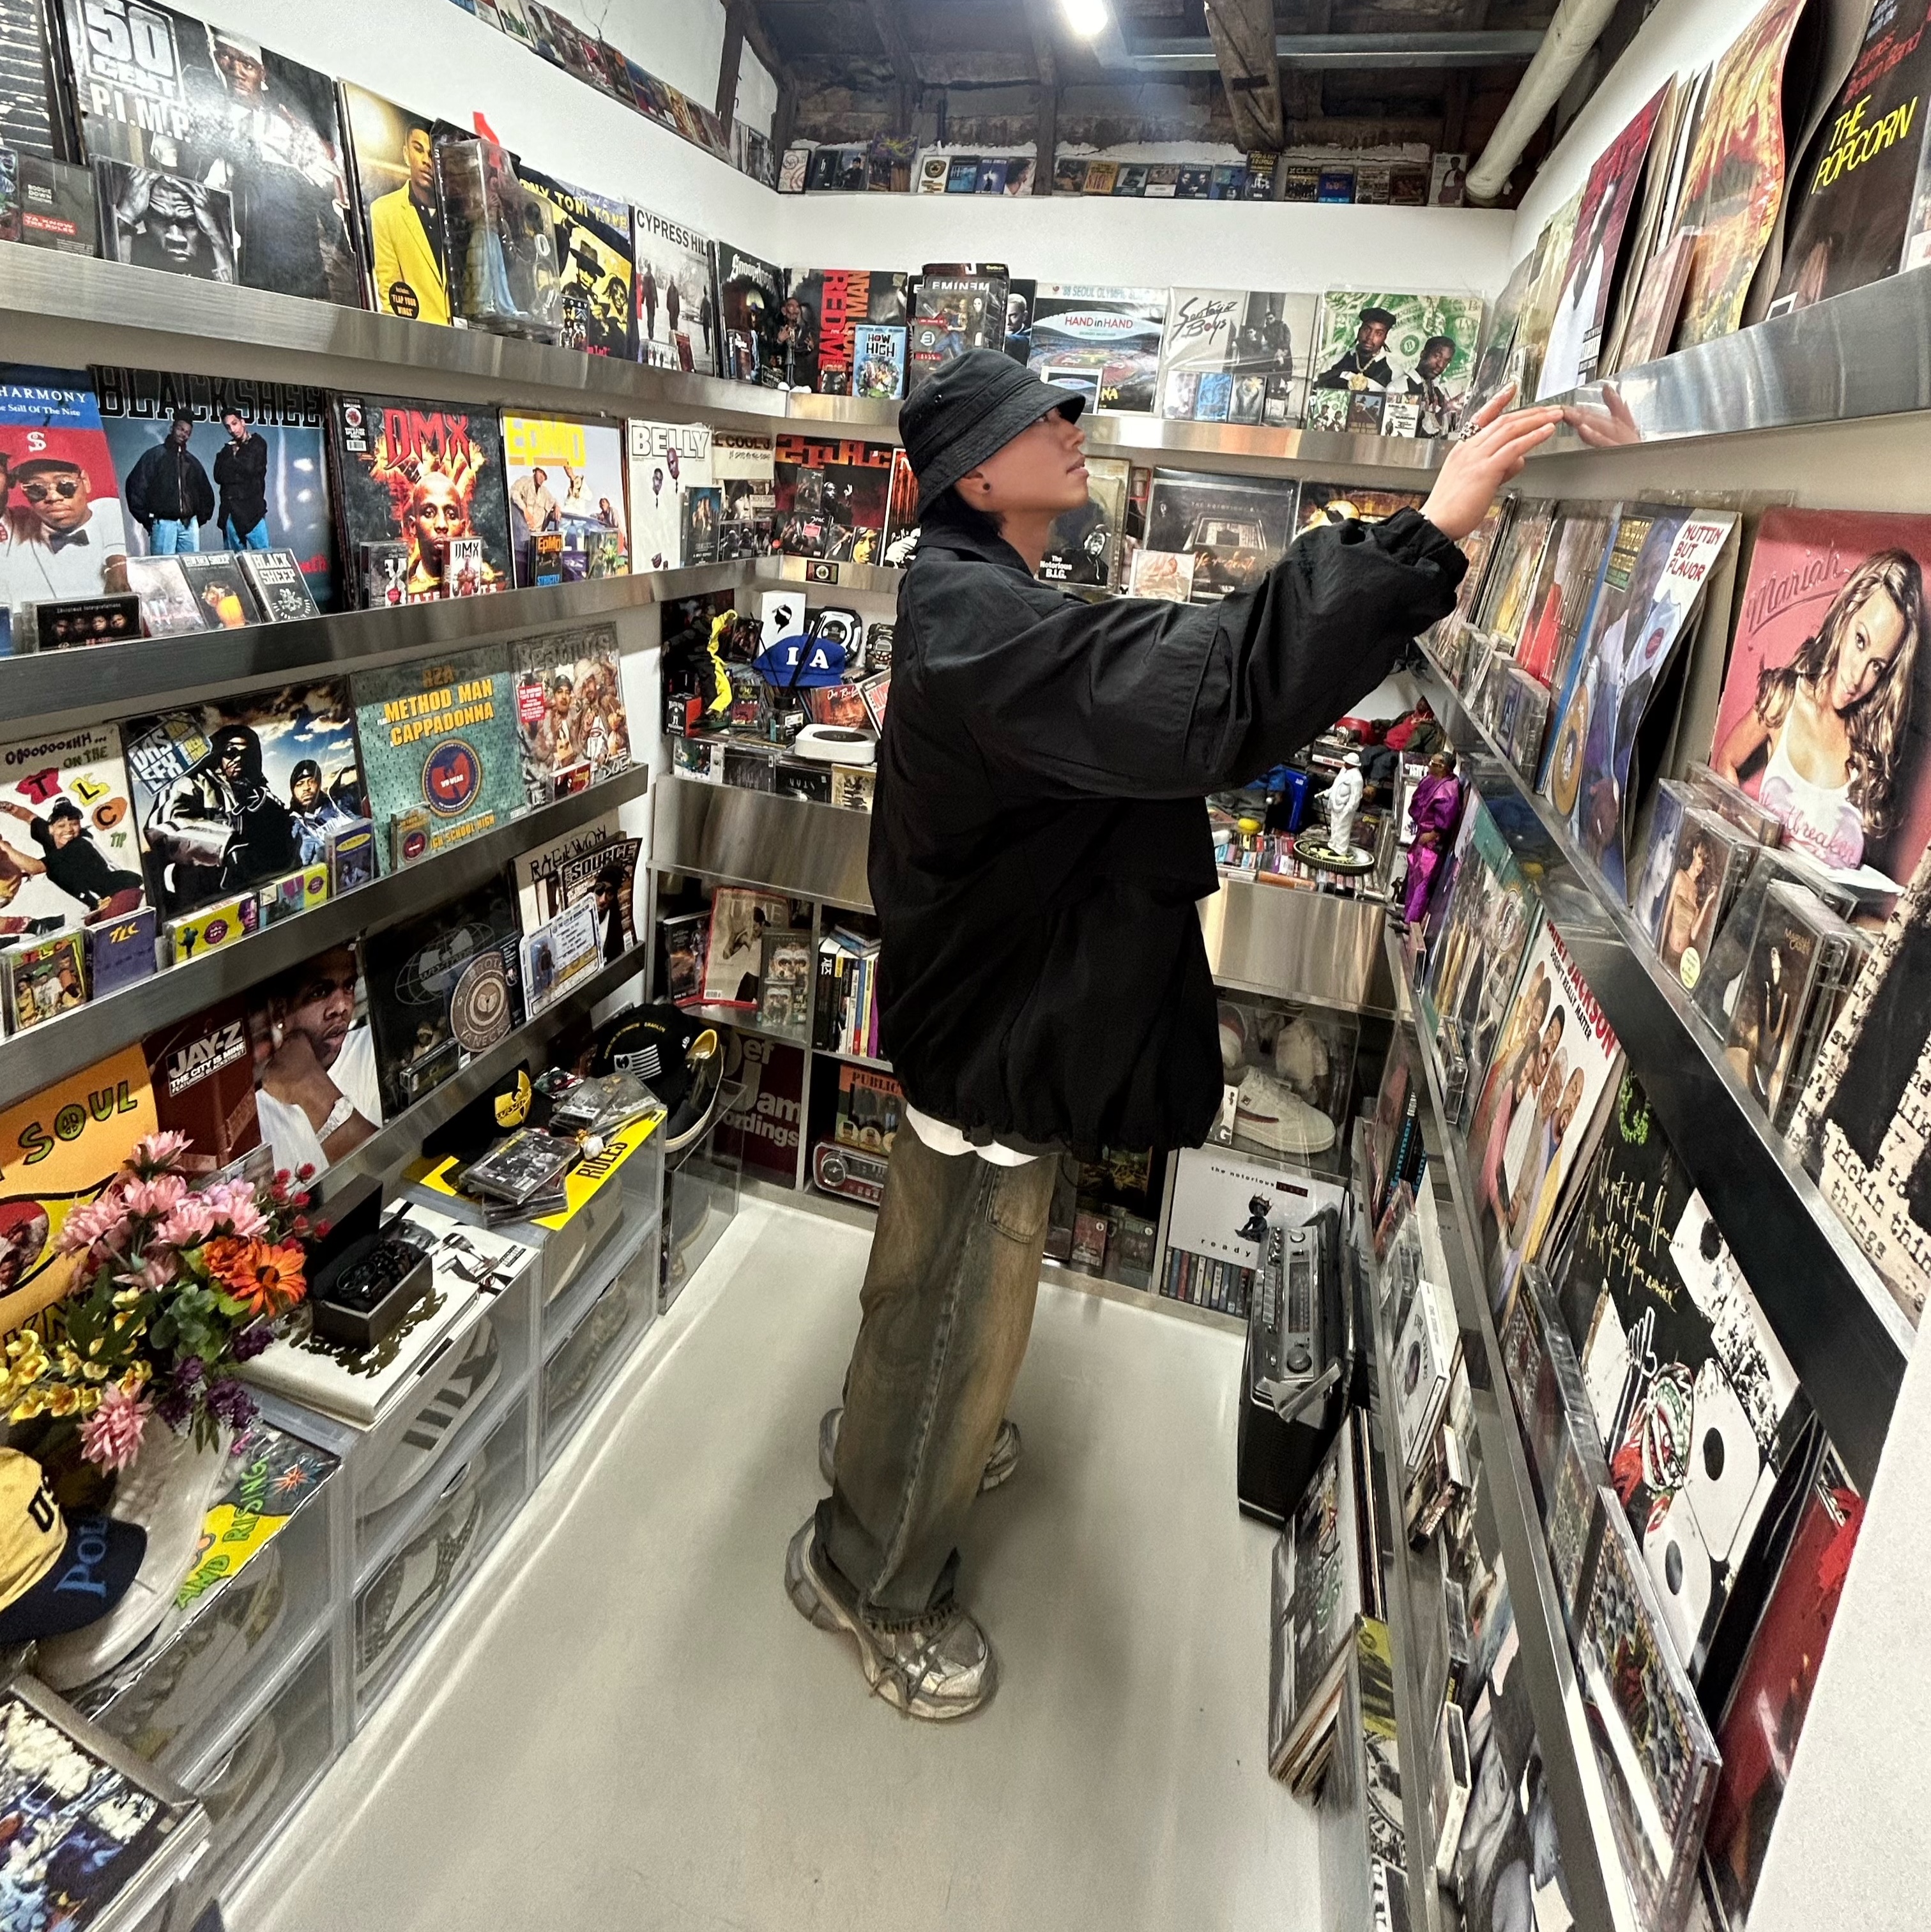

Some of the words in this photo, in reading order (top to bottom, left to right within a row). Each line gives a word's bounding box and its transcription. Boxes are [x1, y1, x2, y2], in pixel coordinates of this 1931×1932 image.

[1829, 95, 1872, 151] THE
[1811, 96, 1918, 195] POPCORN
[554, 191, 588, 218] TONI
[637, 210, 689, 248] CYPRESS
[932, 281, 990, 293] EMINEM
[1072, 285, 1095, 298] SEOUL
[1065, 316, 1094, 327] HAND
[1095, 317, 1103, 328] in
[1104, 317, 1133, 328] HAND
[867, 333, 892, 342] HOW
[866, 342, 895, 358] HIGH
[96, 367, 233, 423] BLACK
[8, 404, 27, 413] Still
[28, 405, 40, 413] Of
[42, 406, 60, 415] The
[383, 407, 471, 471] DMX
[631, 425, 710, 459] BELLY
[725, 436, 764, 449] COOL
[1683, 524, 1725, 545] NUTTIN
[454, 542, 479, 559] DMX
[1051, 554, 1063, 563] The
[1674, 540, 1698, 558] BUT
[184, 556, 209, 567] BLACK
[210, 554, 231, 565] SHEEP
[252, 552, 291, 568] BLACK
[1039, 560, 1072, 572] Notorious
[1666, 558, 1706, 582] FLAVOR
[261, 569, 296, 585] SHEEP
[1746, 540, 1852, 635] Mariah
[384, 688, 453, 724] METHOD
[457, 678, 494, 704] MAN
[390, 701, 494, 747] CAPPADONNA
[445, 825, 475, 844] SCHOOL
[571, 843, 636, 881] SOURCE
[109, 923, 141, 943] TLC
[1550, 946, 1565, 980] DOESN'T
[1562, 975, 1577, 1007] REALLY
[1575, 1005, 1592, 1042] MATTER
[1568, 962, 1617, 1060] JACKSON
[169, 1021, 243, 1079] JAY-Z
[170, 1074, 190, 1088] THE
[191, 1060, 211, 1077] CITY
[213, 1054, 222, 1064] IS
[223, 1042, 245, 1058] MINE
[172, 1072, 205, 1093] FEATURING
[576, 1141, 629, 1180] RULES
[1211, 1166, 1226, 1175] the
[1230, 1171, 1275, 1187] notorious
[1831, 1178, 1887, 1261] things
[1201, 1238, 1251, 1258] ready
[176, 1554, 231, 1610] AND
[221, 1455, 269, 1543] RISING
